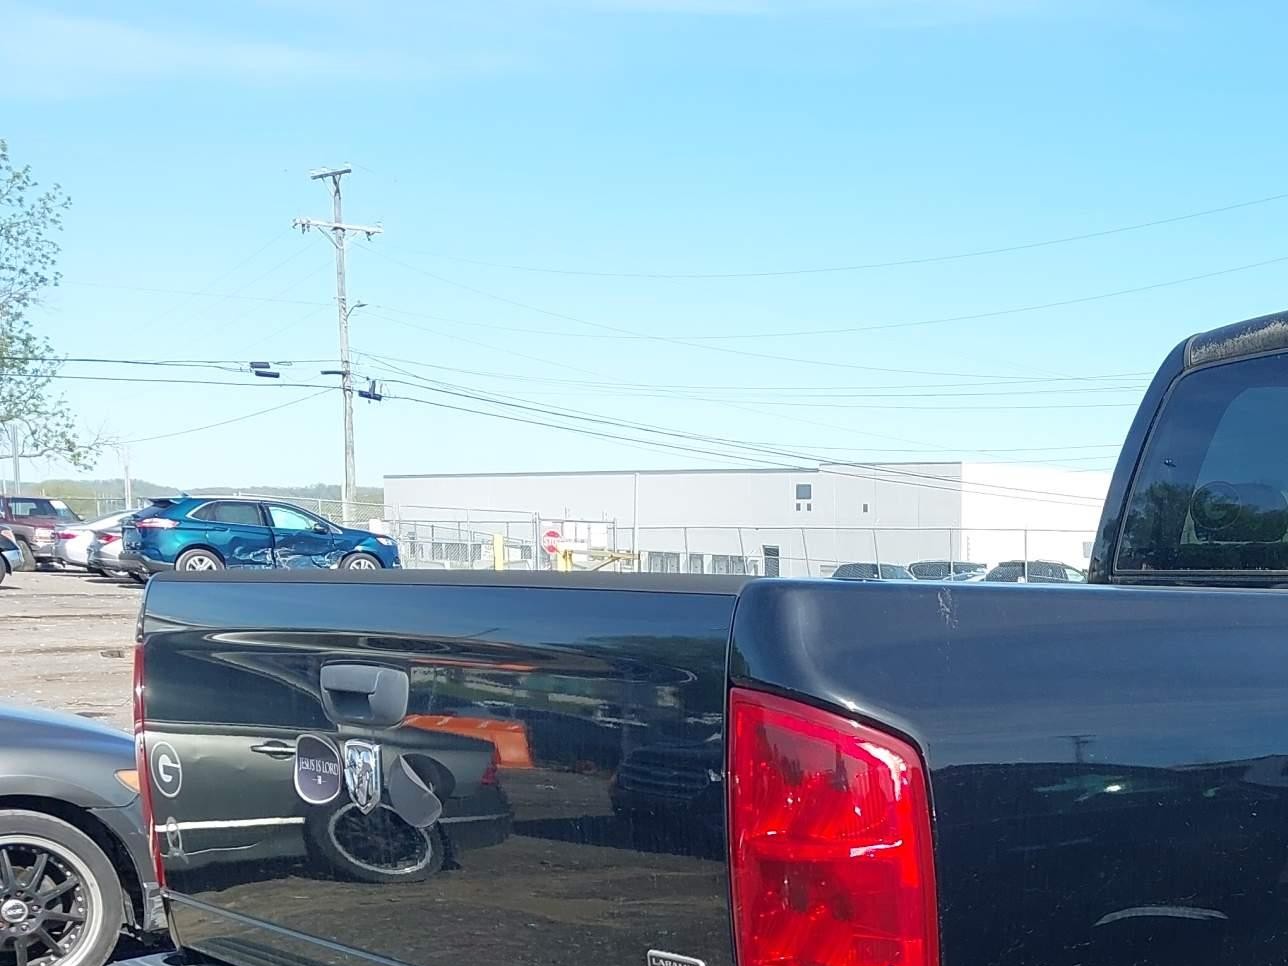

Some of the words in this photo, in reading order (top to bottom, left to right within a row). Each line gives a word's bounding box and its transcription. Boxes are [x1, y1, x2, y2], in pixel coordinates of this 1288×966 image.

[150, 741, 183, 798] G
[299, 757, 315, 772] JESUS
[315, 759, 322, 773] IS
[322, 761, 339, 776] LORD
